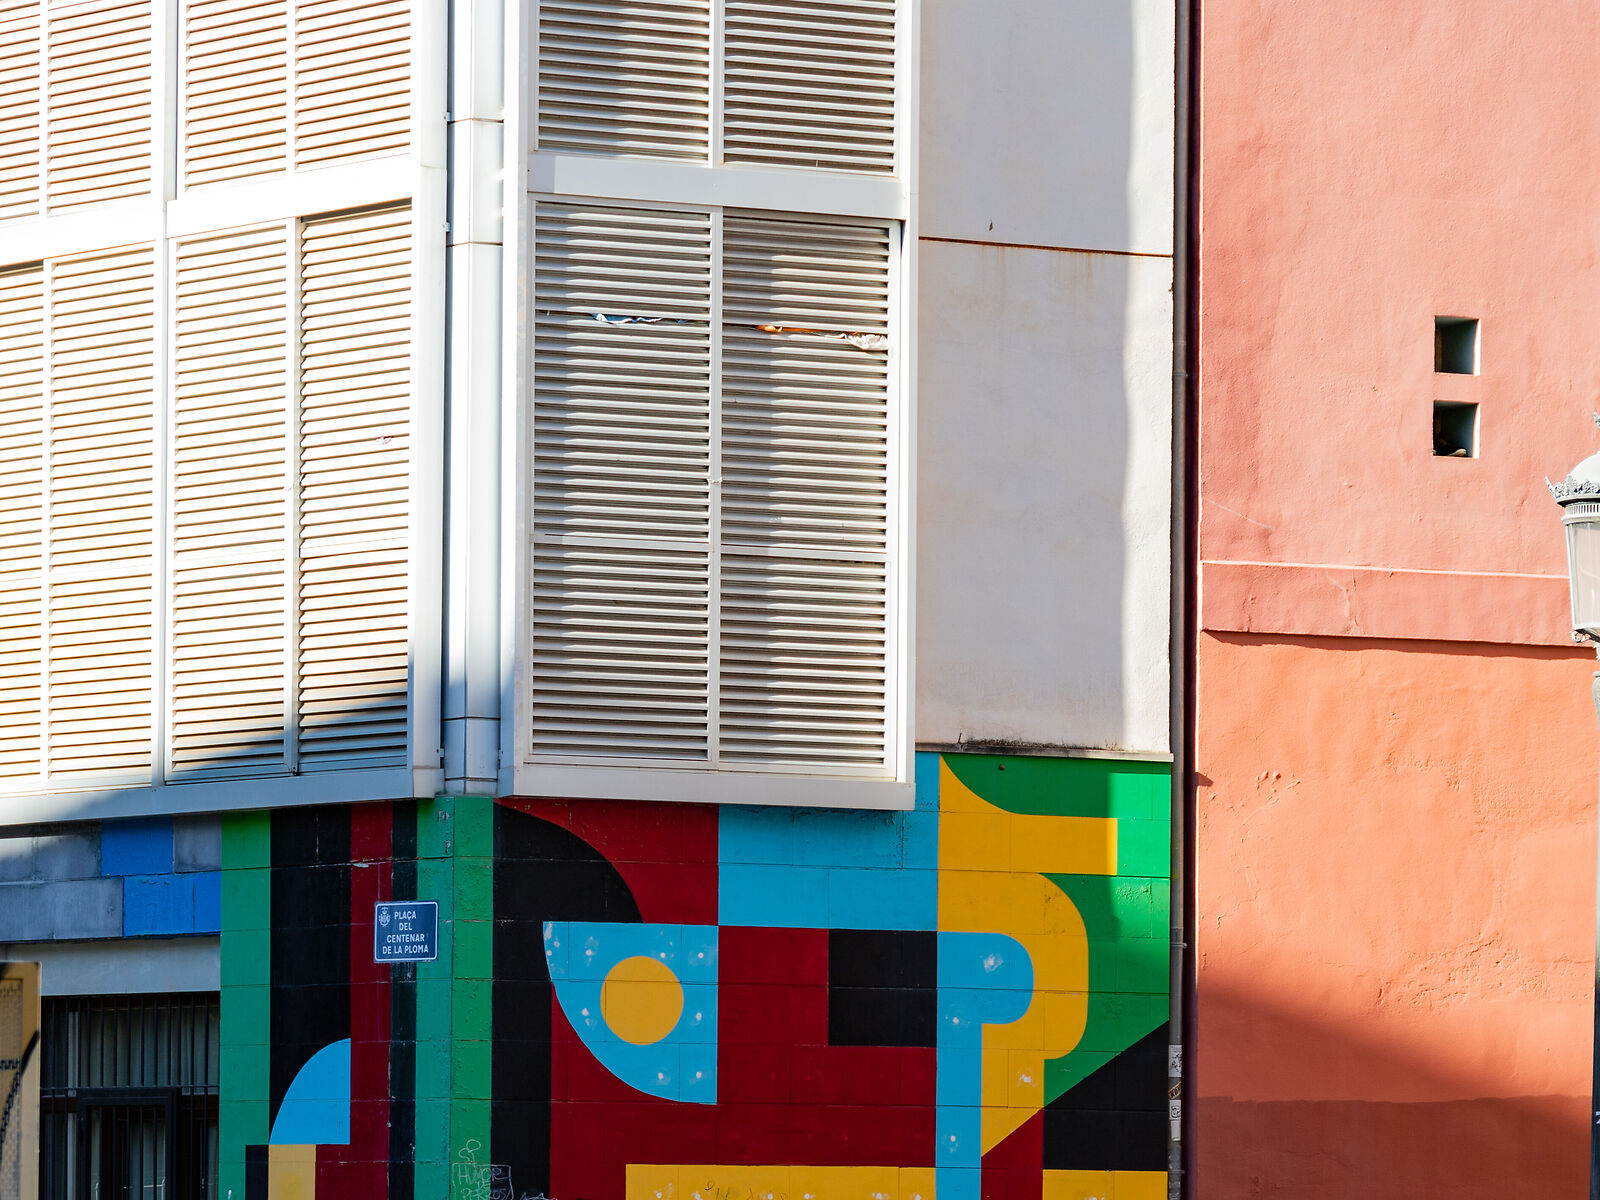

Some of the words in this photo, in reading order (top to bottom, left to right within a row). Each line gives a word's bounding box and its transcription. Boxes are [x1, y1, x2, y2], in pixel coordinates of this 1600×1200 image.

[394, 911, 417, 920] PLAÇA
[399, 923, 413, 931] DEL
[386, 933, 425, 943] CENTENAR
[382, 946, 392, 954] DE
[394, 945, 403, 954] LA
[404, 944, 429, 954] PLOMA
